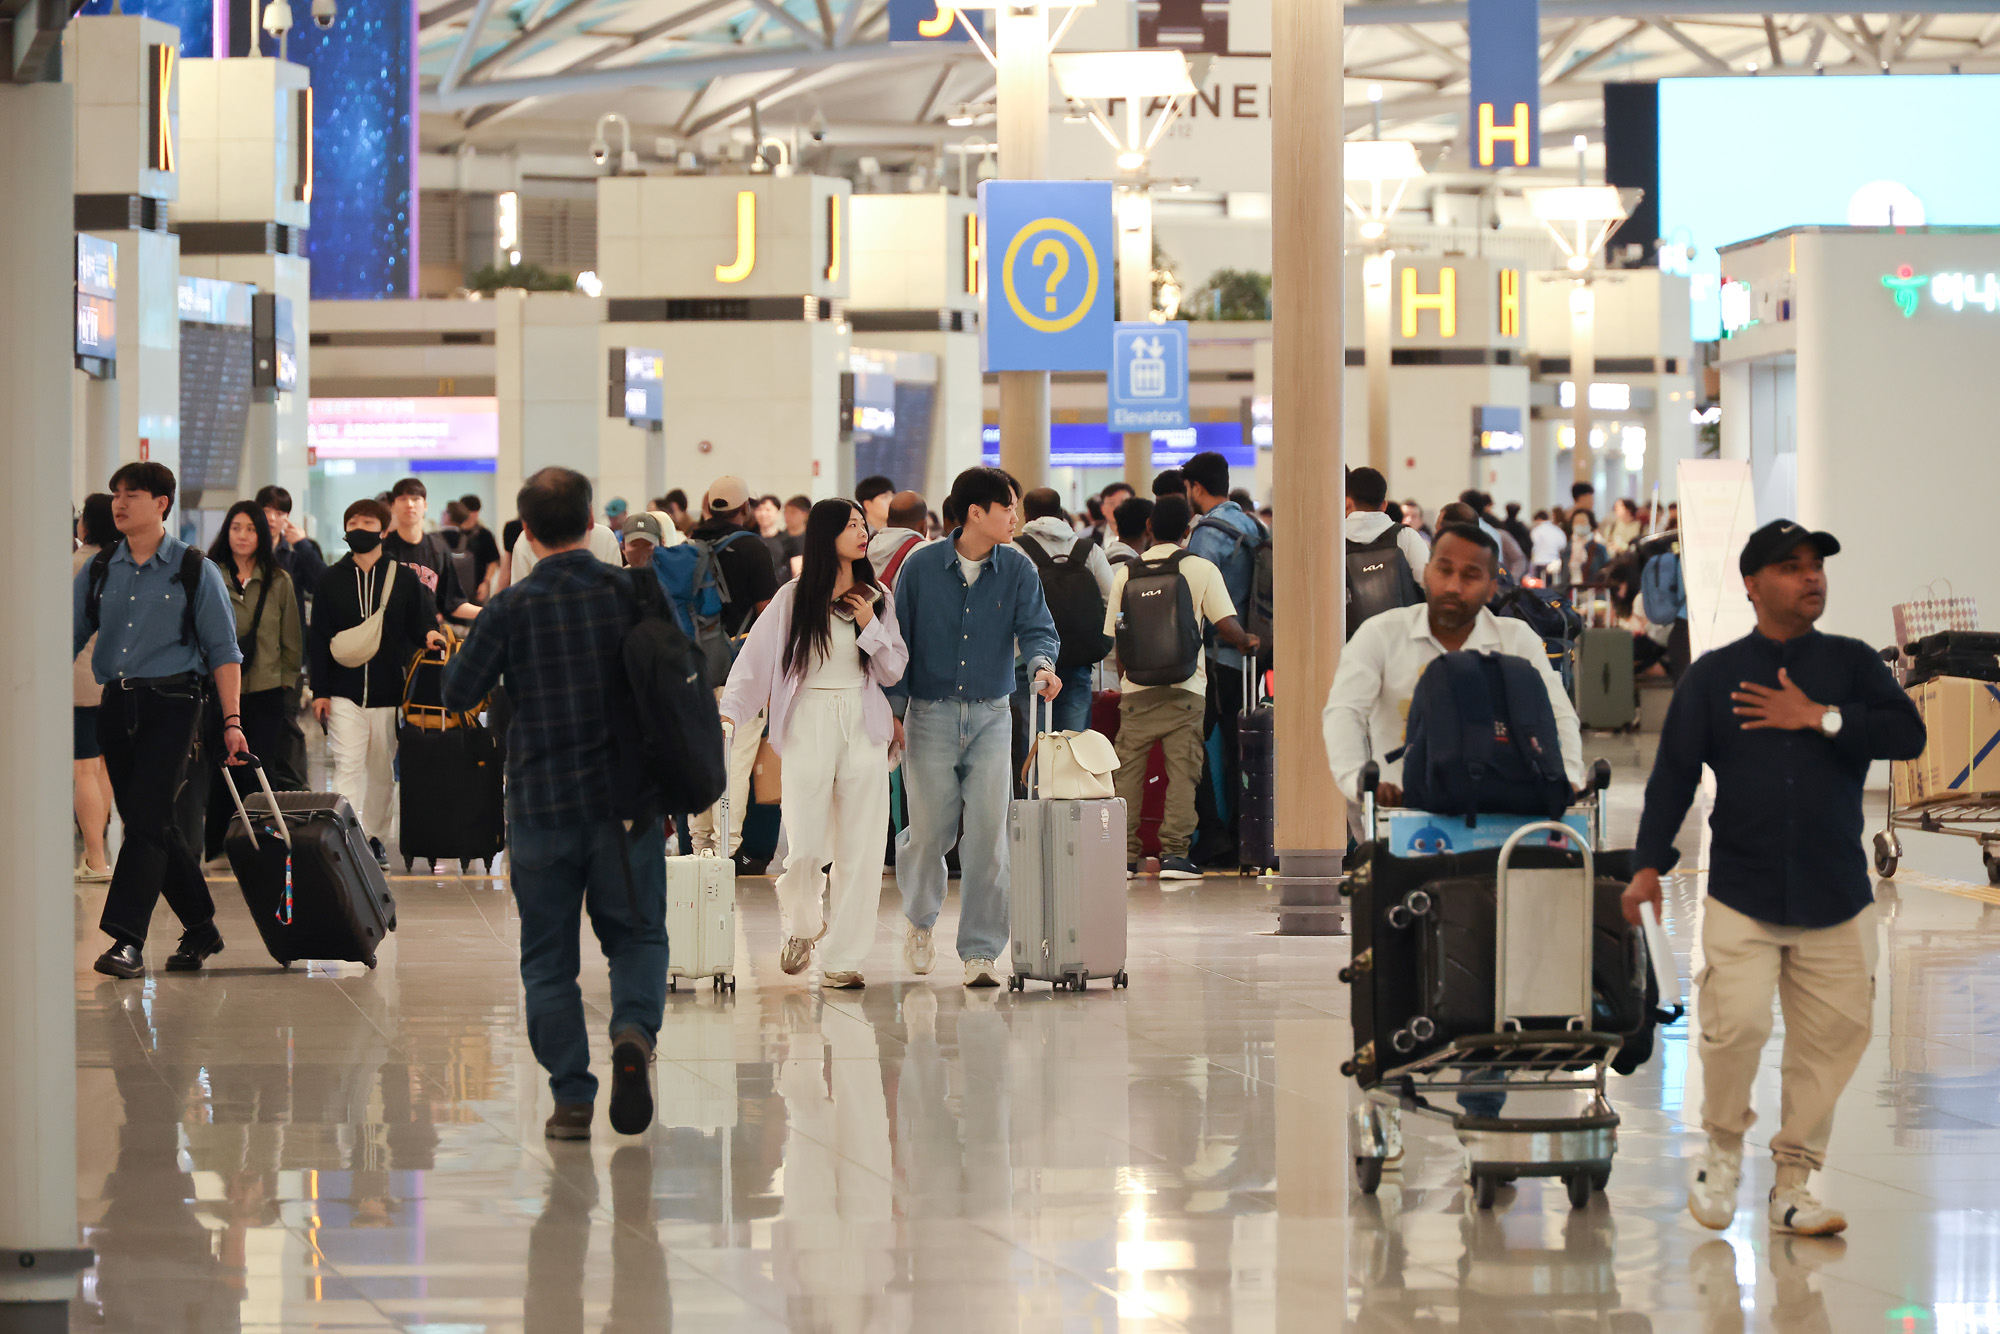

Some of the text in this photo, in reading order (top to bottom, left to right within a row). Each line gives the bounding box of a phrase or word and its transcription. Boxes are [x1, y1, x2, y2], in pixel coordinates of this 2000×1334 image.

[159, 42, 176, 174] K
[1479, 103, 1530, 166] H
[715, 190, 756, 283] J
[1401, 266, 1457, 338] H
[1501, 267, 1520, 338] H
[1114, 408, 1184, 426] Elevators
